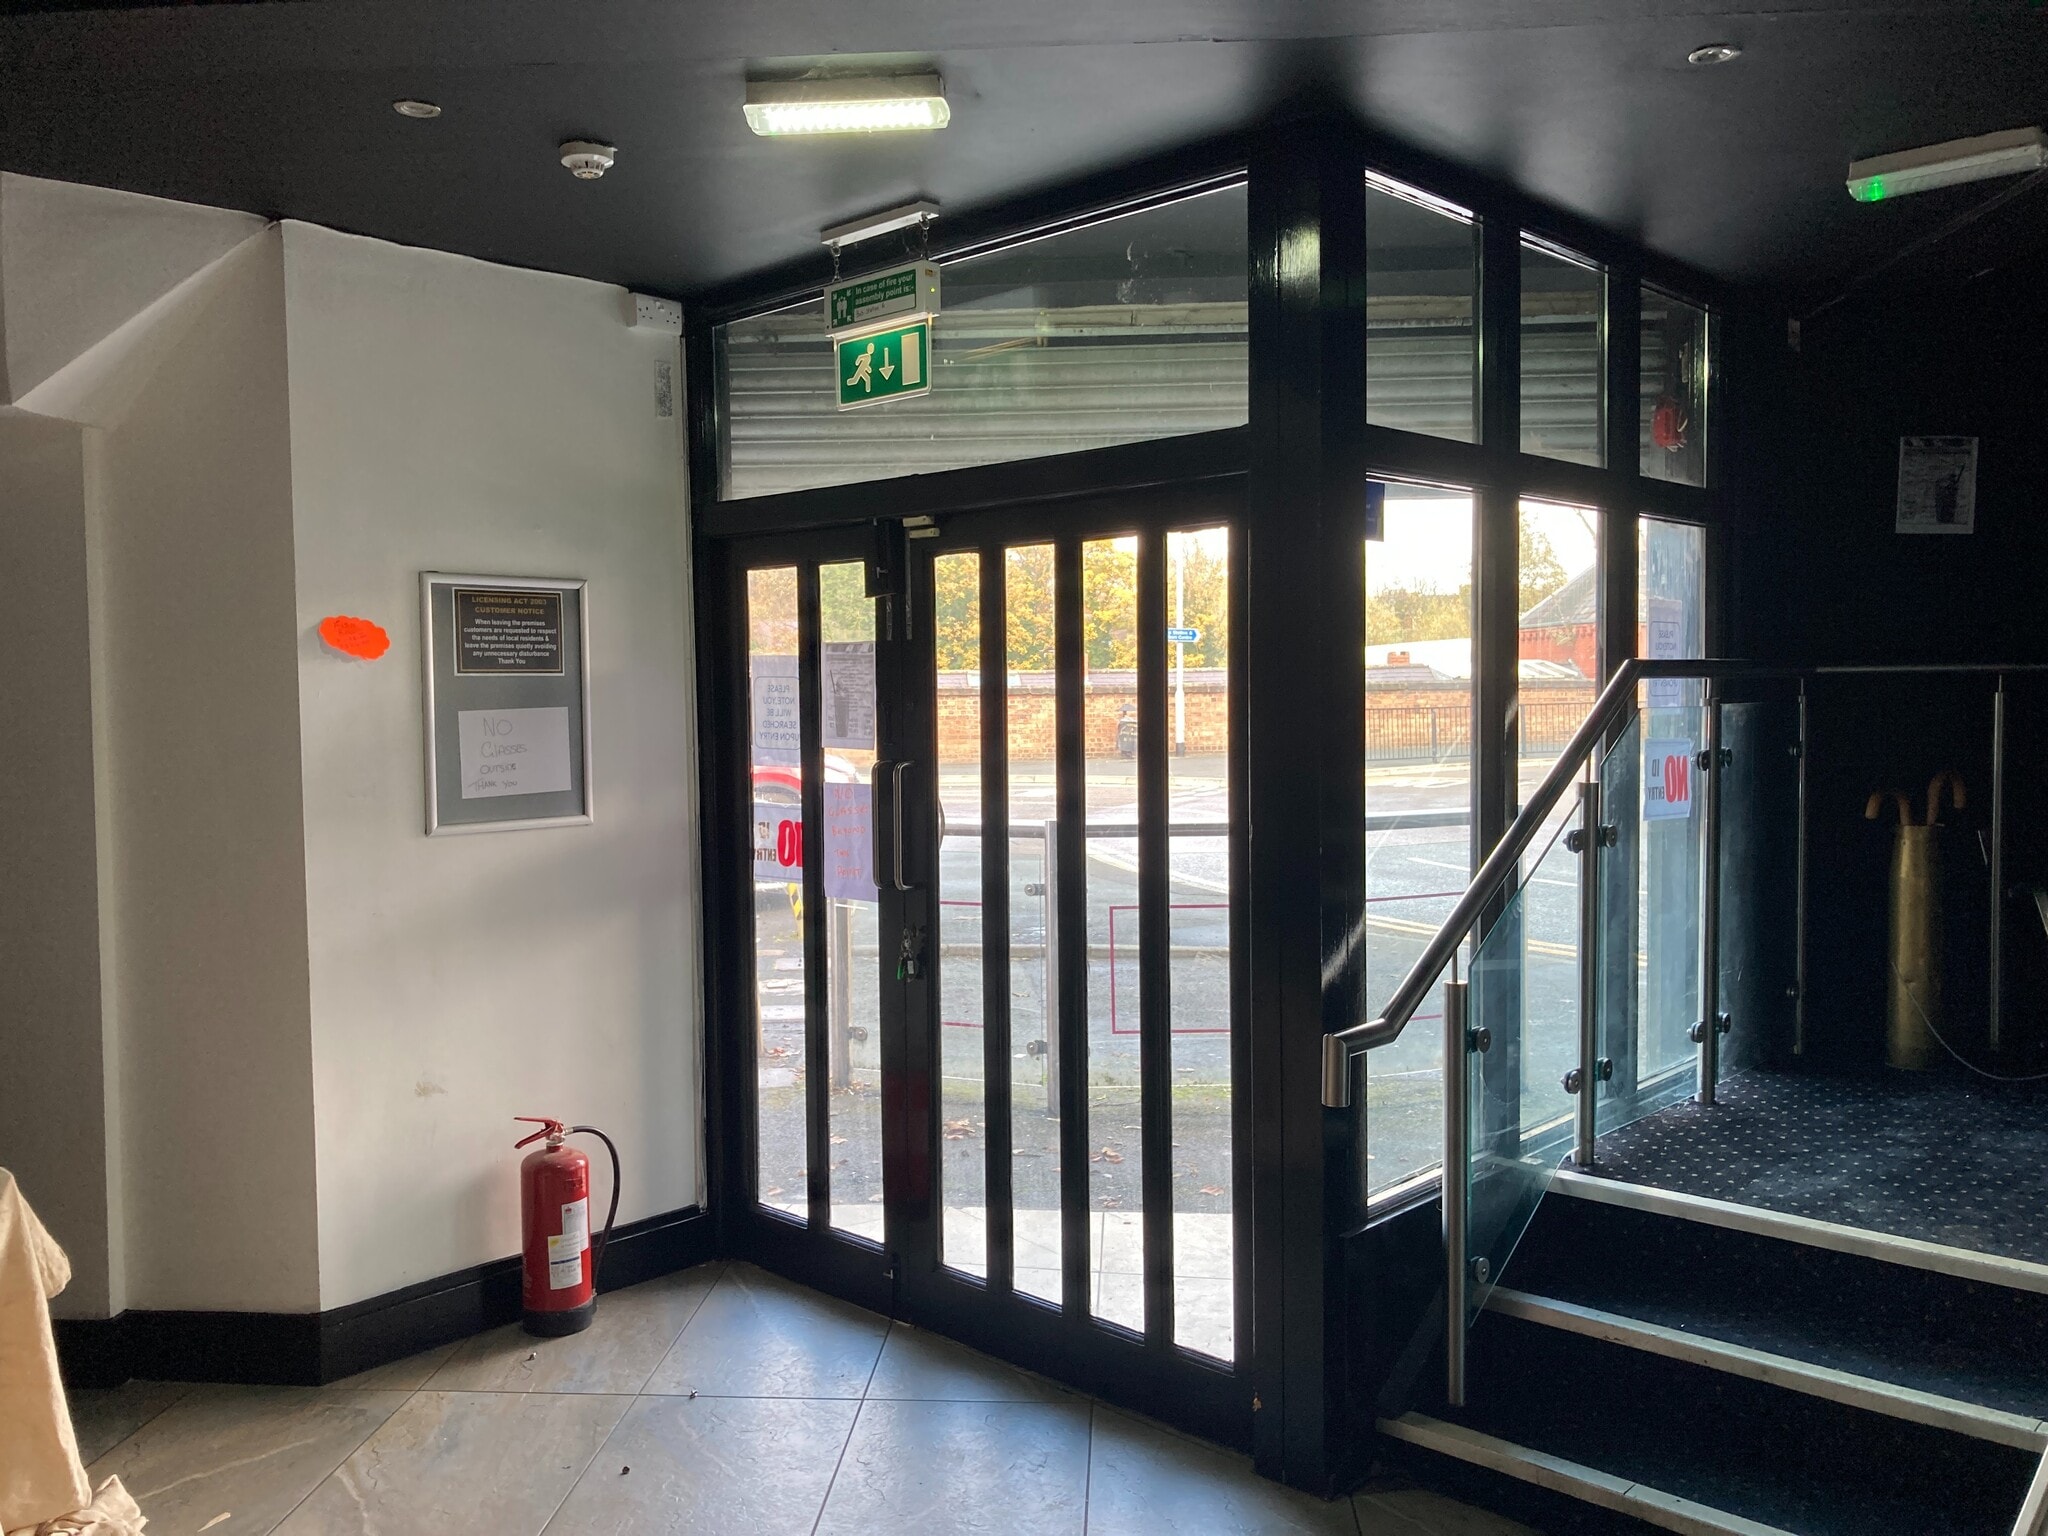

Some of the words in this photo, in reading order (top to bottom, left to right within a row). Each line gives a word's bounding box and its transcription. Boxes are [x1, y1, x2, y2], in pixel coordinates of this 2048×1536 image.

[855, 287, 861, 295] In
[863, 283, 878, 293] case
[878, 280, 886, 289] of
[886, 278, 897, 286] fire
[898, 274, 913, 286] your
[855, 291, 885, 305] assembly
[886, 287, 902, 299] point
[471, 596, 512, 604] LICENSING
[513, 597, 529, 605] ACT
[474, 606, 516, 614] CUSTOMER
[517, 607, 545, 615] NOTICE
[491, 619, 511, 627] leaving
[503, 627, 530, 635] requested
[505, 634, 519, 642] local
[515, 643, 534, 651] quietly
[472, 650, 483, 658] any
[497, 657, 515, 665] Thank
[515, 657, 527, 665] You
[482, 717, 513, 737] NO
[468, 778, 498, 792] THANK
